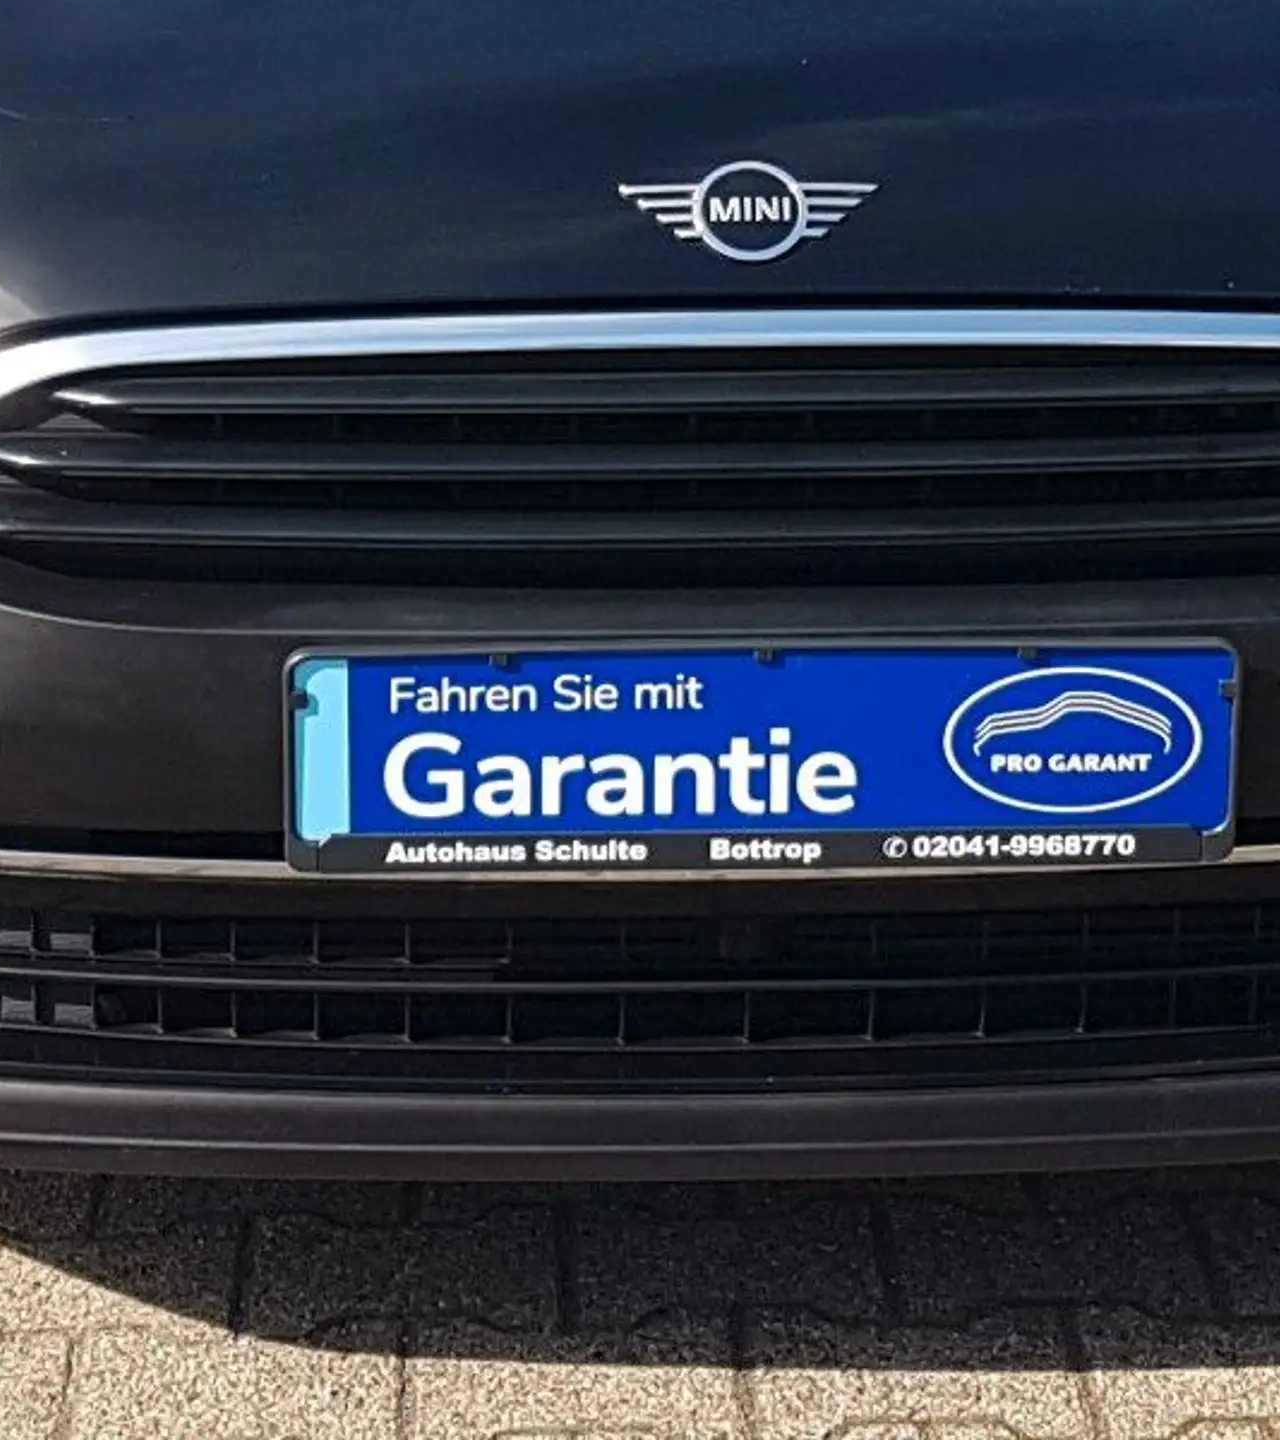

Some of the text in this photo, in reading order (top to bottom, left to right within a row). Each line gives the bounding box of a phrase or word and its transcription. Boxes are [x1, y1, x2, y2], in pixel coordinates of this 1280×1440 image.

[709, 196, 790, 222] MINI
[389, 673, 703, 714] Fahren Sie mit
[383, 727, 858, 818] Garantie
[990, 753, 1152, 773] PRO GARANT
[385, 834, 1136, 864] Autohaus Schulte Bottrop 02041-9968770
